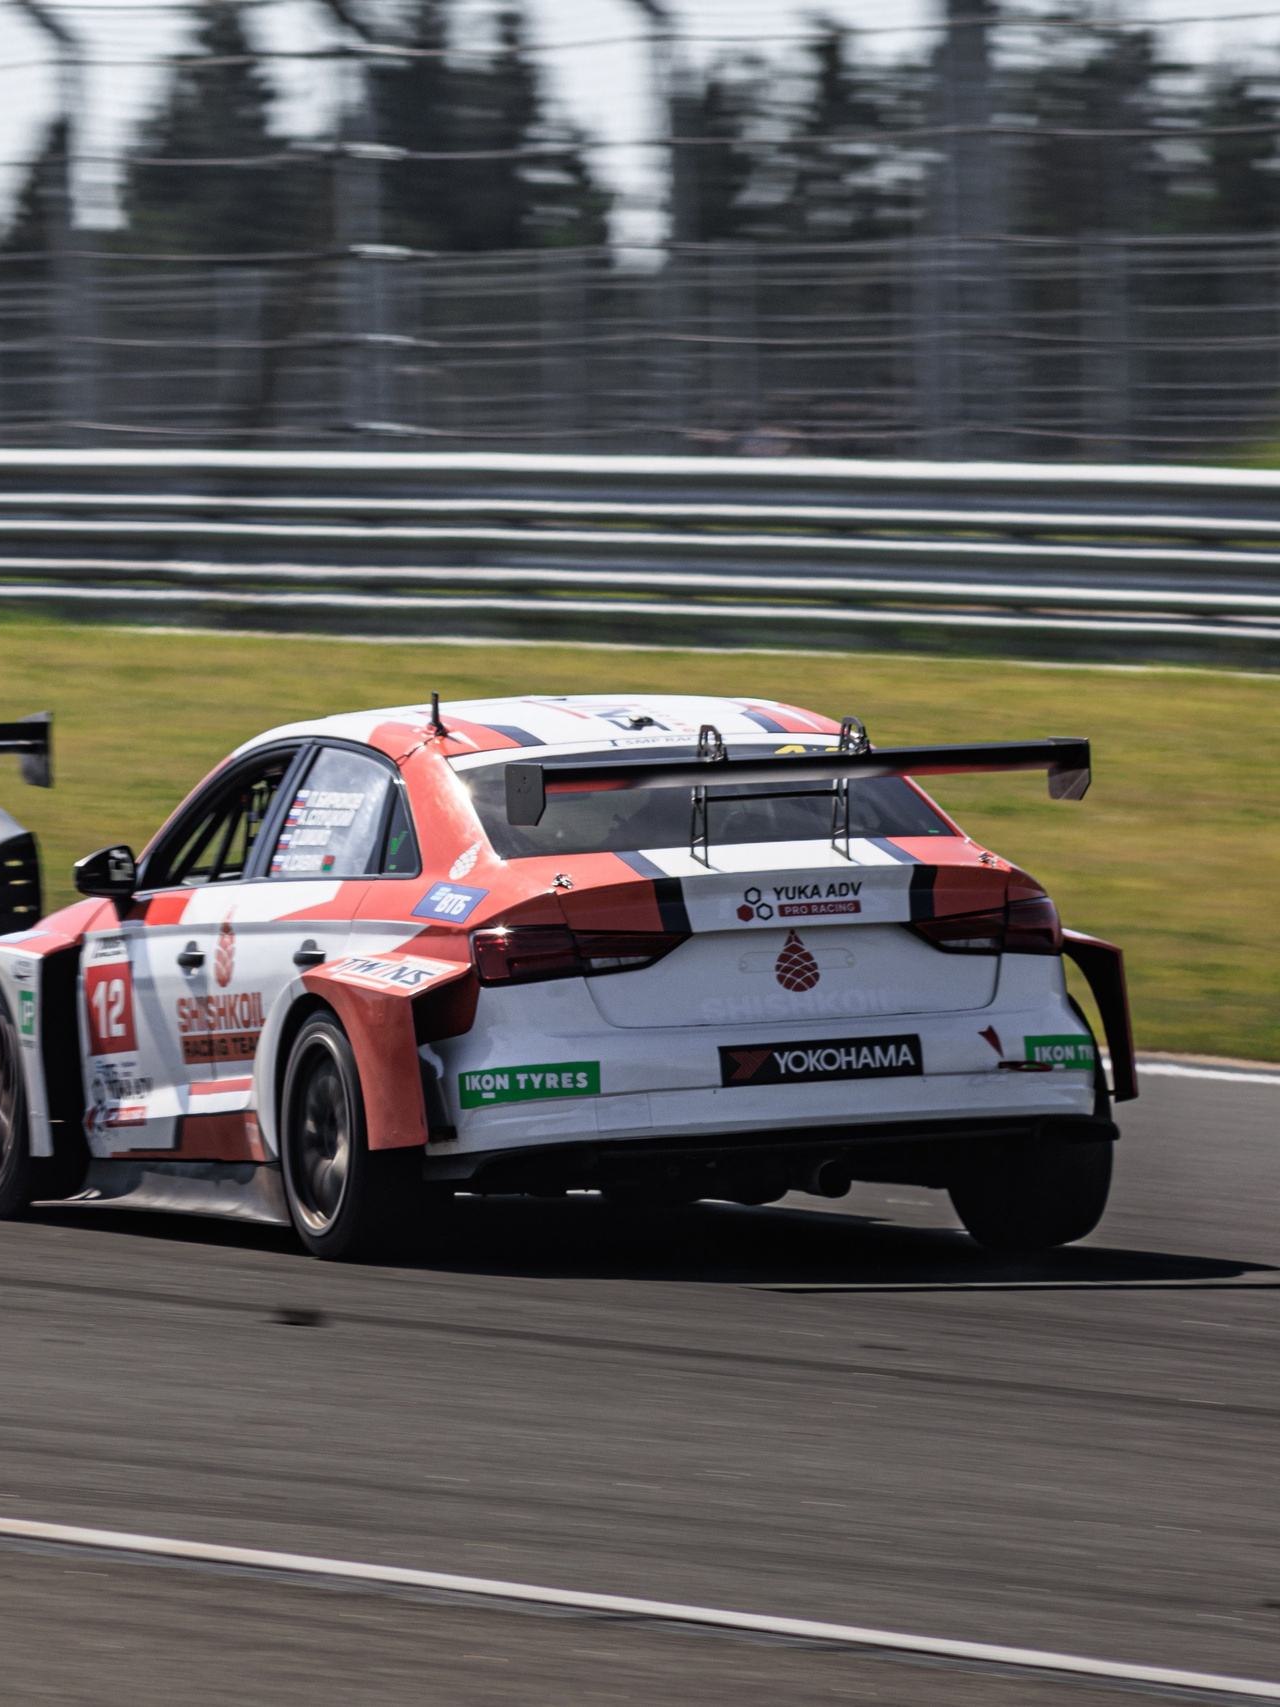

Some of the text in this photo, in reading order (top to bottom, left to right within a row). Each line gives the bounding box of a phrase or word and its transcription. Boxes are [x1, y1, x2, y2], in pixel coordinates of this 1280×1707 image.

[773, 882, 862, 901] YUKA ADV
[434, 893, 472, 915] ВТБ
[784, 902, 856, 915] PRO RACING
[336, 958, 436, 986] TWINS
[92, 978, 127, 1039] 12
[177, 992, 268, 1034] SHISHKOIL
[773, 1044, 916, 1074] YOKOHAMA
[1034, 1045, 1076, 1063] IKON
[465, 1072, 589, 1092] IKON TYRES
